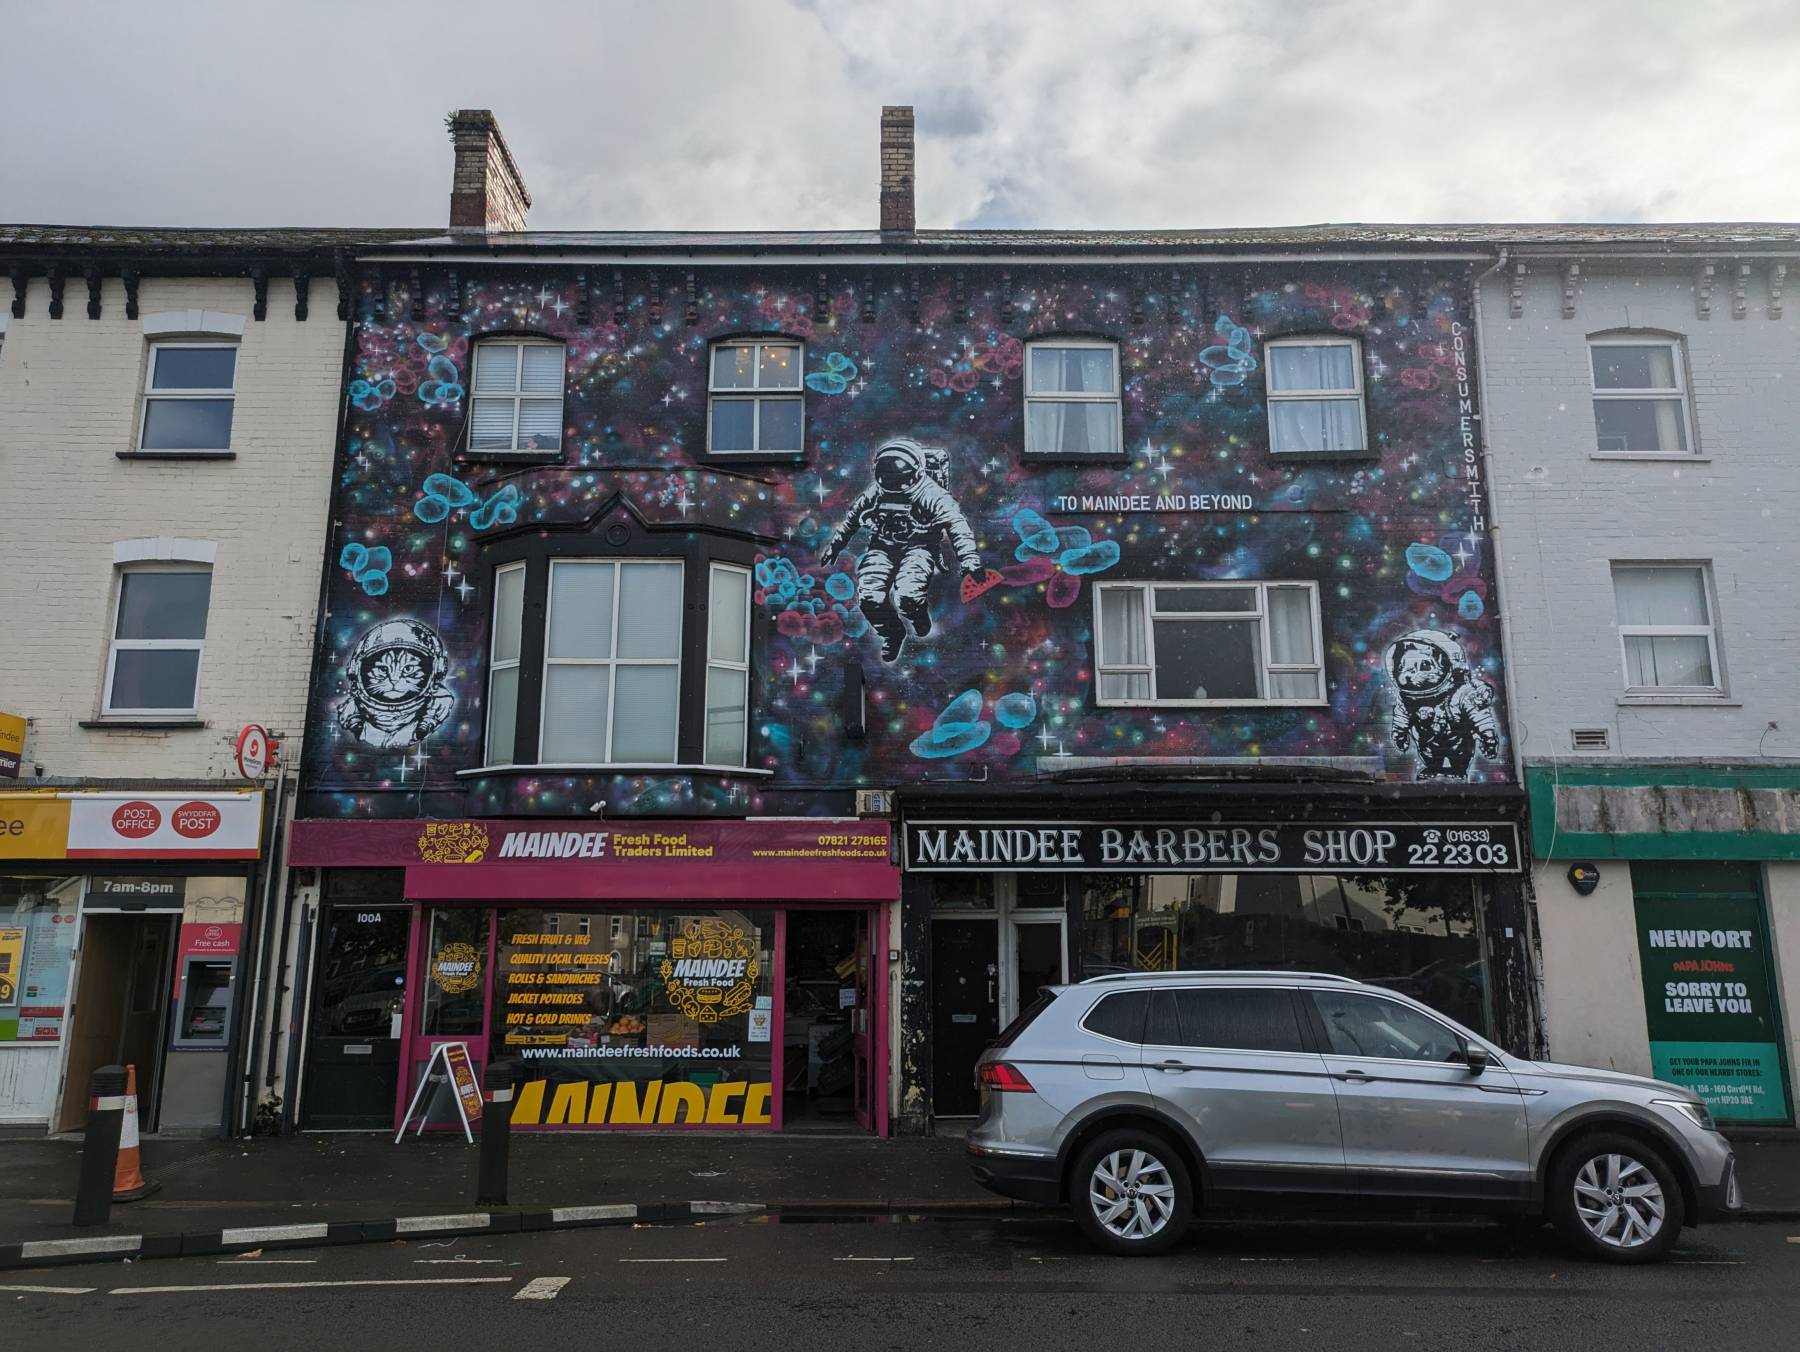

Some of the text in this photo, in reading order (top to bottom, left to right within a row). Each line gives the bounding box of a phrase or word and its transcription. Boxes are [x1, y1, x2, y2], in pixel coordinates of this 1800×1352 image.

[1451, 321, 1484, 531] CONSUMERSMITH
[1058, 494, 1252, 511] TO MAINDEE AND BEYOND
[124, 809, 152, 818] POST
[116, 819, 156, 829] OFFICE
[179, 818, 214, 830] POST
[614, 834, 687, 845] Fresh Food
[818, 836, 887, 845] 07821 278165
[1446, 828, 1490, 842] (01633)
[498, 832, 609, 858] MAINDEE
[916, 828, 1397, 865] MAINDEE BARBERS SHOP
[614, 846, 713, 857] Traders Limited
[752, 848, 887, 857] www.maindeefreshfoods.co.uk
[103, 881, 174, 894] 7am-8pm
[195, 939, 230, 947] Free cash
[511, 934, 539, 945] FRESH
[540, 934, 564, 945] FRUIT
[565, 934, 572, 945] &
[1649, 929, 1752, 949] NEWPORT
[510, 953, 610, 964] QUALITY LOCAL CHEESES
[438, 961, 474, 972] MAINDEE
[673, 960, 747, 977] MAINDEE
[1673, 960, 1699, 972] PAPA
[508, 973, 602, 984] ROLLS & SANDWICHES
[683, 978, 734, 987] Fresh Food
[1665, 982, 1747, 997] SORRY TO
[507, 994, 584, 1004] JACKET POTATOES
[1665, 998, 1752, 1014] LEAVE YOU
[506, 1013, 592, 1025] HOT & COLD DRINKS
[522, 1044, 741, 1059] www.maindeefreshfoods.co.uk
[1682, 1057, 1700, 1066] YOUR
[1700, 1057, 1718, 1066] PAPA
